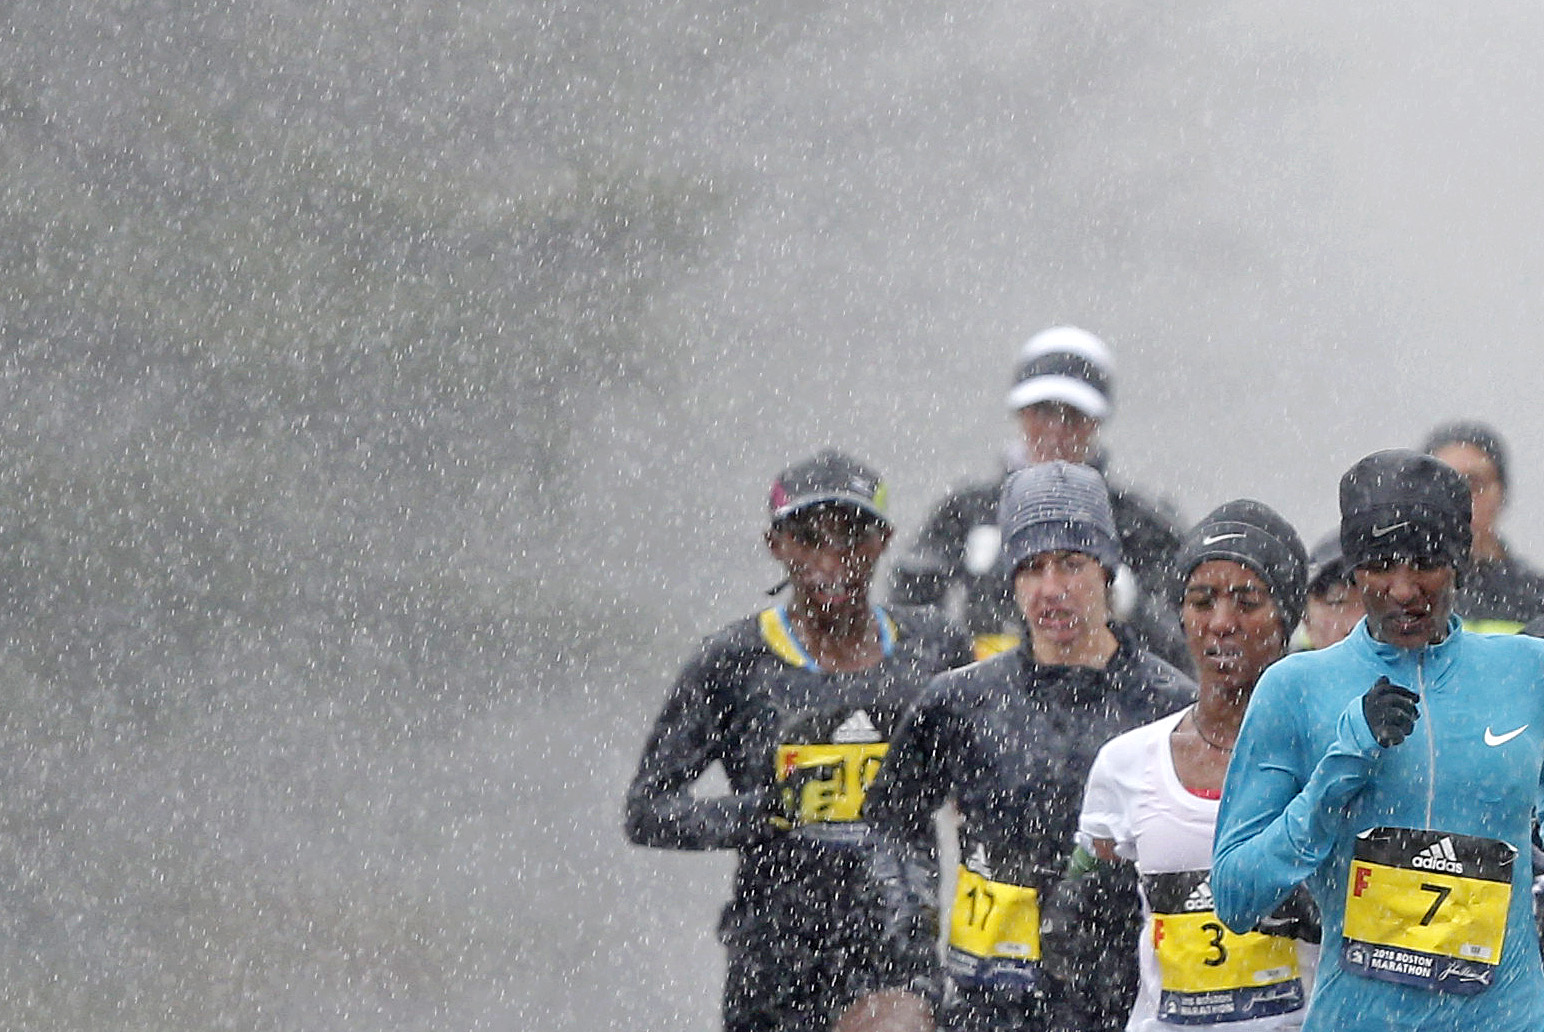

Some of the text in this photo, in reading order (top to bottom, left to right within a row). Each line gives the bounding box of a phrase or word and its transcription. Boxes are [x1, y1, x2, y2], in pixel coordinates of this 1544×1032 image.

[1411, 856, 1464, 874] adidas
[1353, 866, 1372, 897] F
[967, 886, 995, 931] 17
[1419, 882, 1453, 927] 7
[1153, 918, 1165, 949] F
[1201, 922, 1227, 966] 3
[1371, 958, 1432, 978] MARATHON
[1372, 948, 1434, 967] 2018 BOSTON
